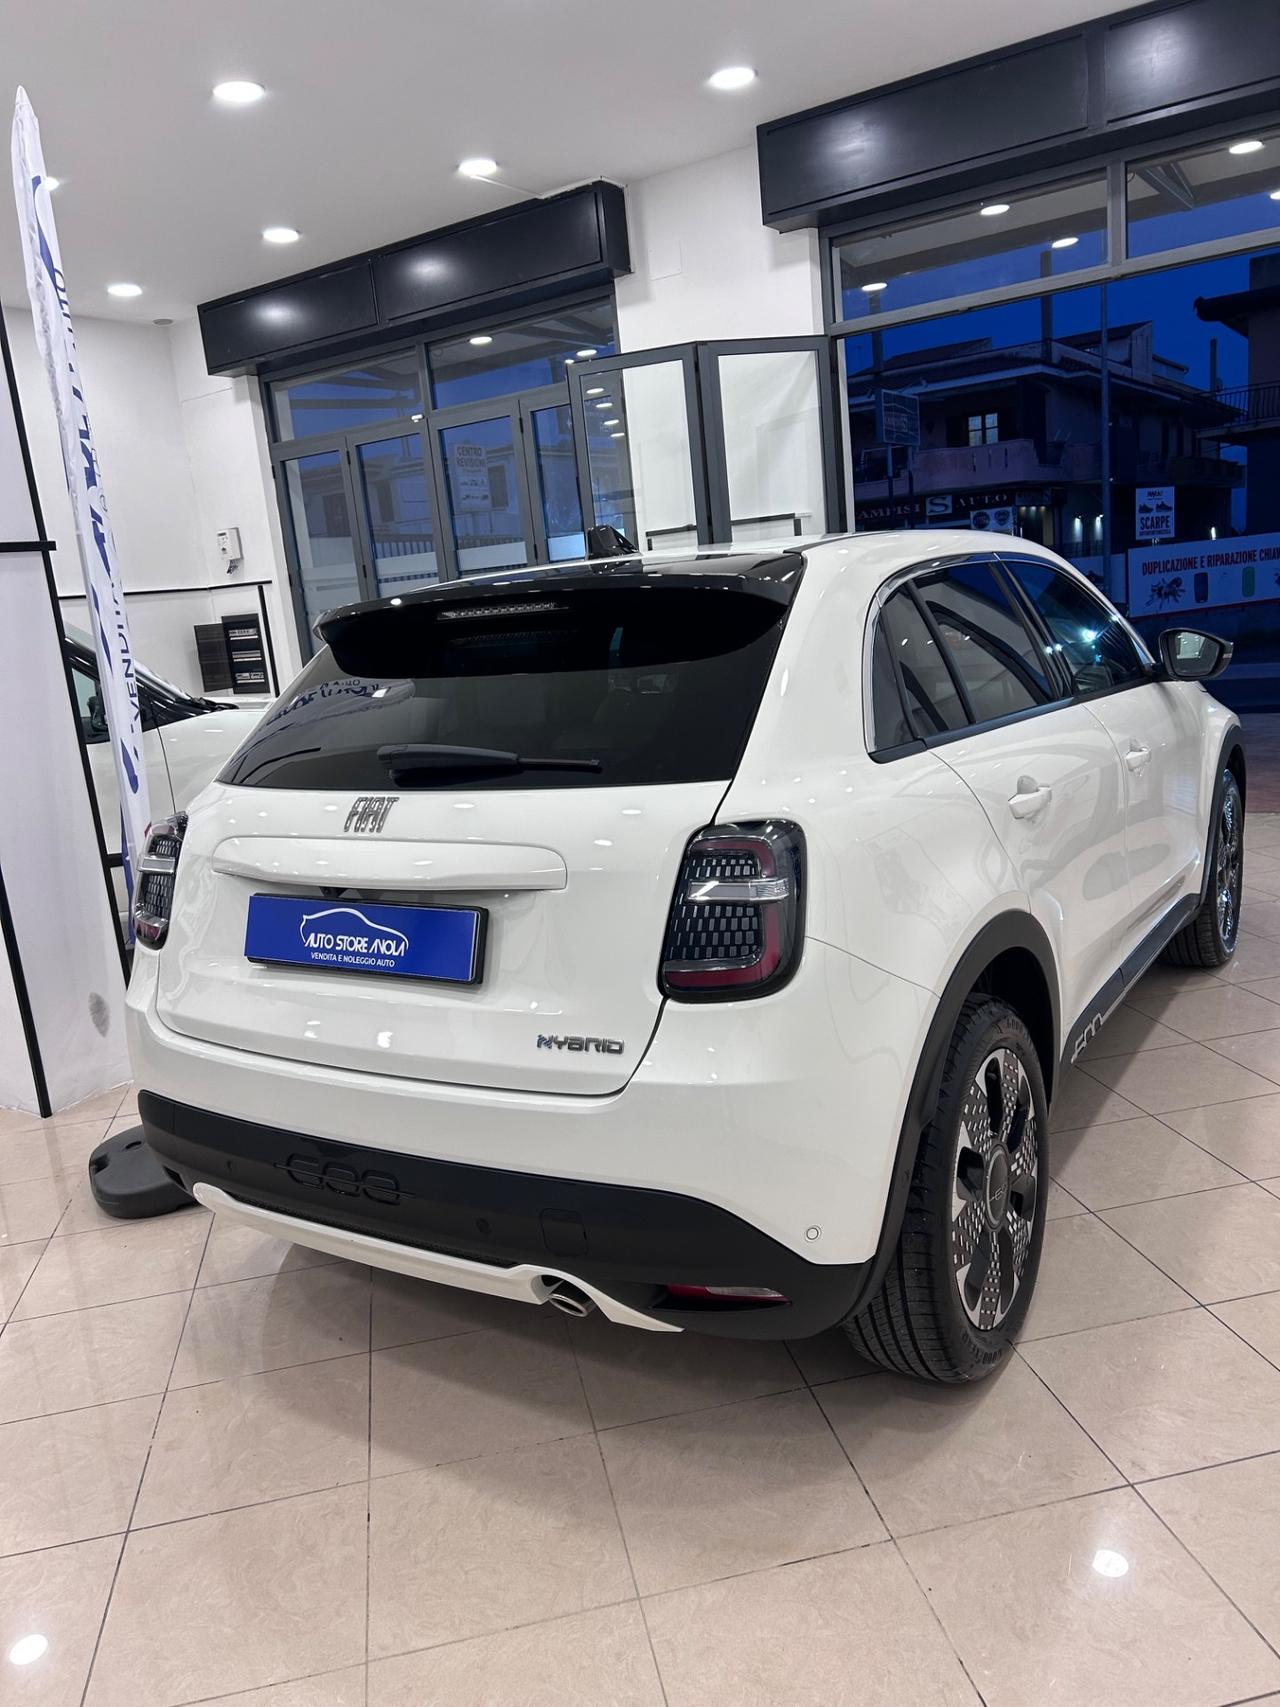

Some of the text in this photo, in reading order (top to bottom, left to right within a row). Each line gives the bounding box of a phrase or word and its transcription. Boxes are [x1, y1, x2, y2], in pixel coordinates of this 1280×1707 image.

[1140, 515, 1171, 530] SCARPE
[1142, 557, 1198, 576] DUPLICAZIONE
[1200, 556, 1205, 568] E
[1207, 550, 1257, 568] RIPARAZIONE
[343, 796, 400, 833] FIAT
[304, 932, 334, 949] AUTO
[336, 935, 368, 952] STORE
[311, 952, 395, 968] VENDITA E NOLEGGIO AUTO
[537, 1034, 625, 1055] HYBRID
